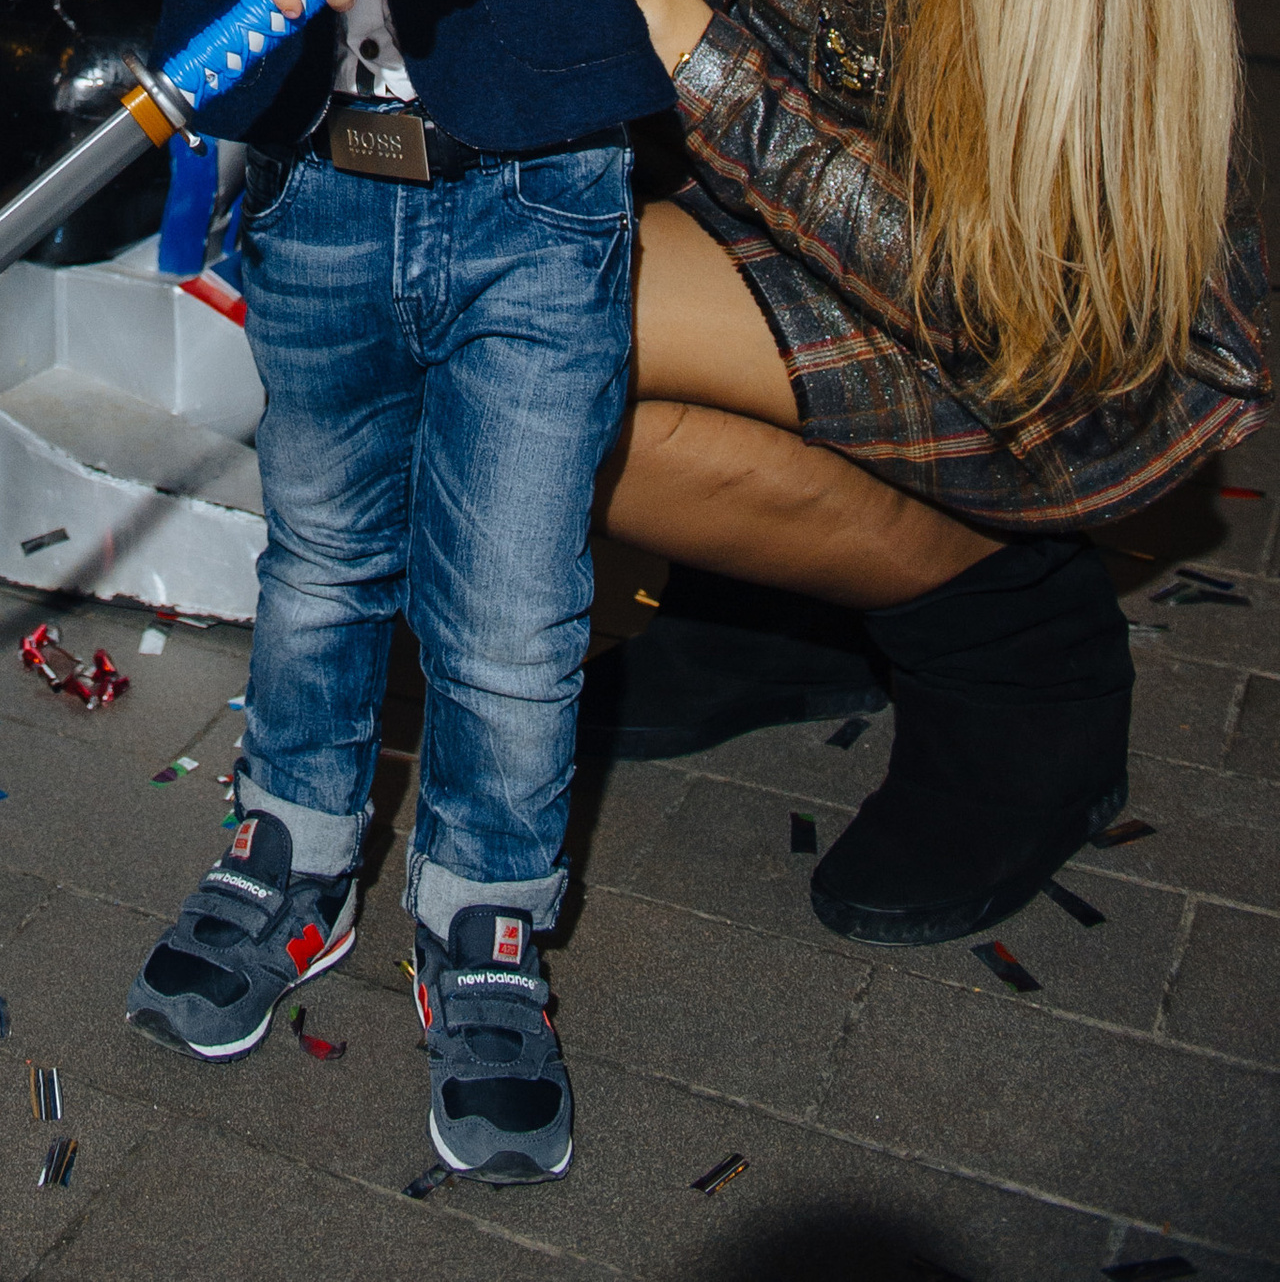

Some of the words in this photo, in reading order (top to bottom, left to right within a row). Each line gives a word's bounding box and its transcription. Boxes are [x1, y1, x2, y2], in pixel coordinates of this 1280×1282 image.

[346, 128, 402, 152] BOSS
[223, 873, 267, 898] balance
[457, 973, 485, 987] new
[486, 971, 535, 990] balance
